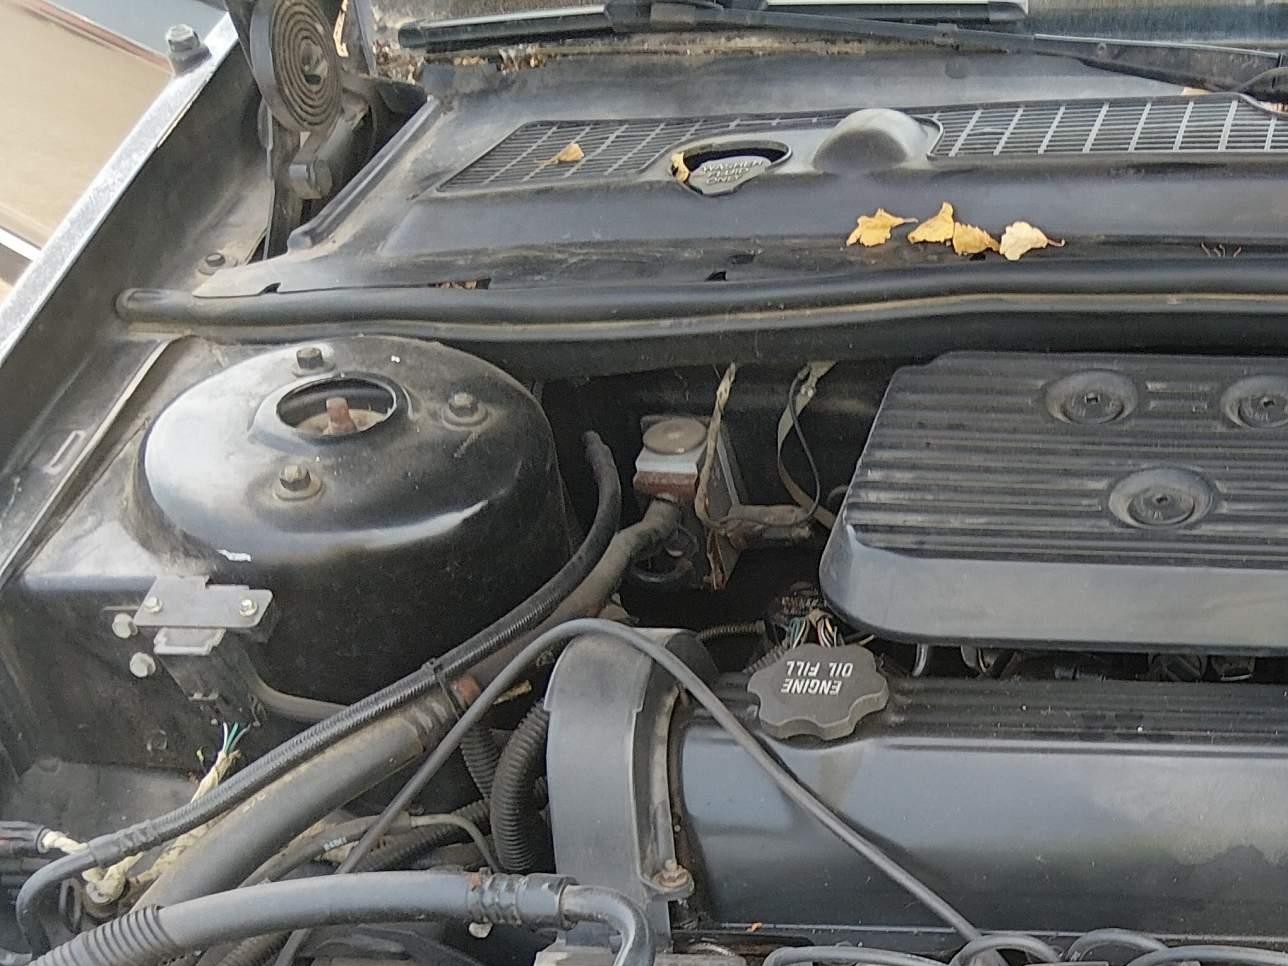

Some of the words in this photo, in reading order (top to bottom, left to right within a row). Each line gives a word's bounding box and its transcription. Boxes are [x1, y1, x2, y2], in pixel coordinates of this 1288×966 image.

[786, 660, 820, 677] FILL
[828, 662, 853, 677] OIL
[781, 678, 842, 696] ENGINE
